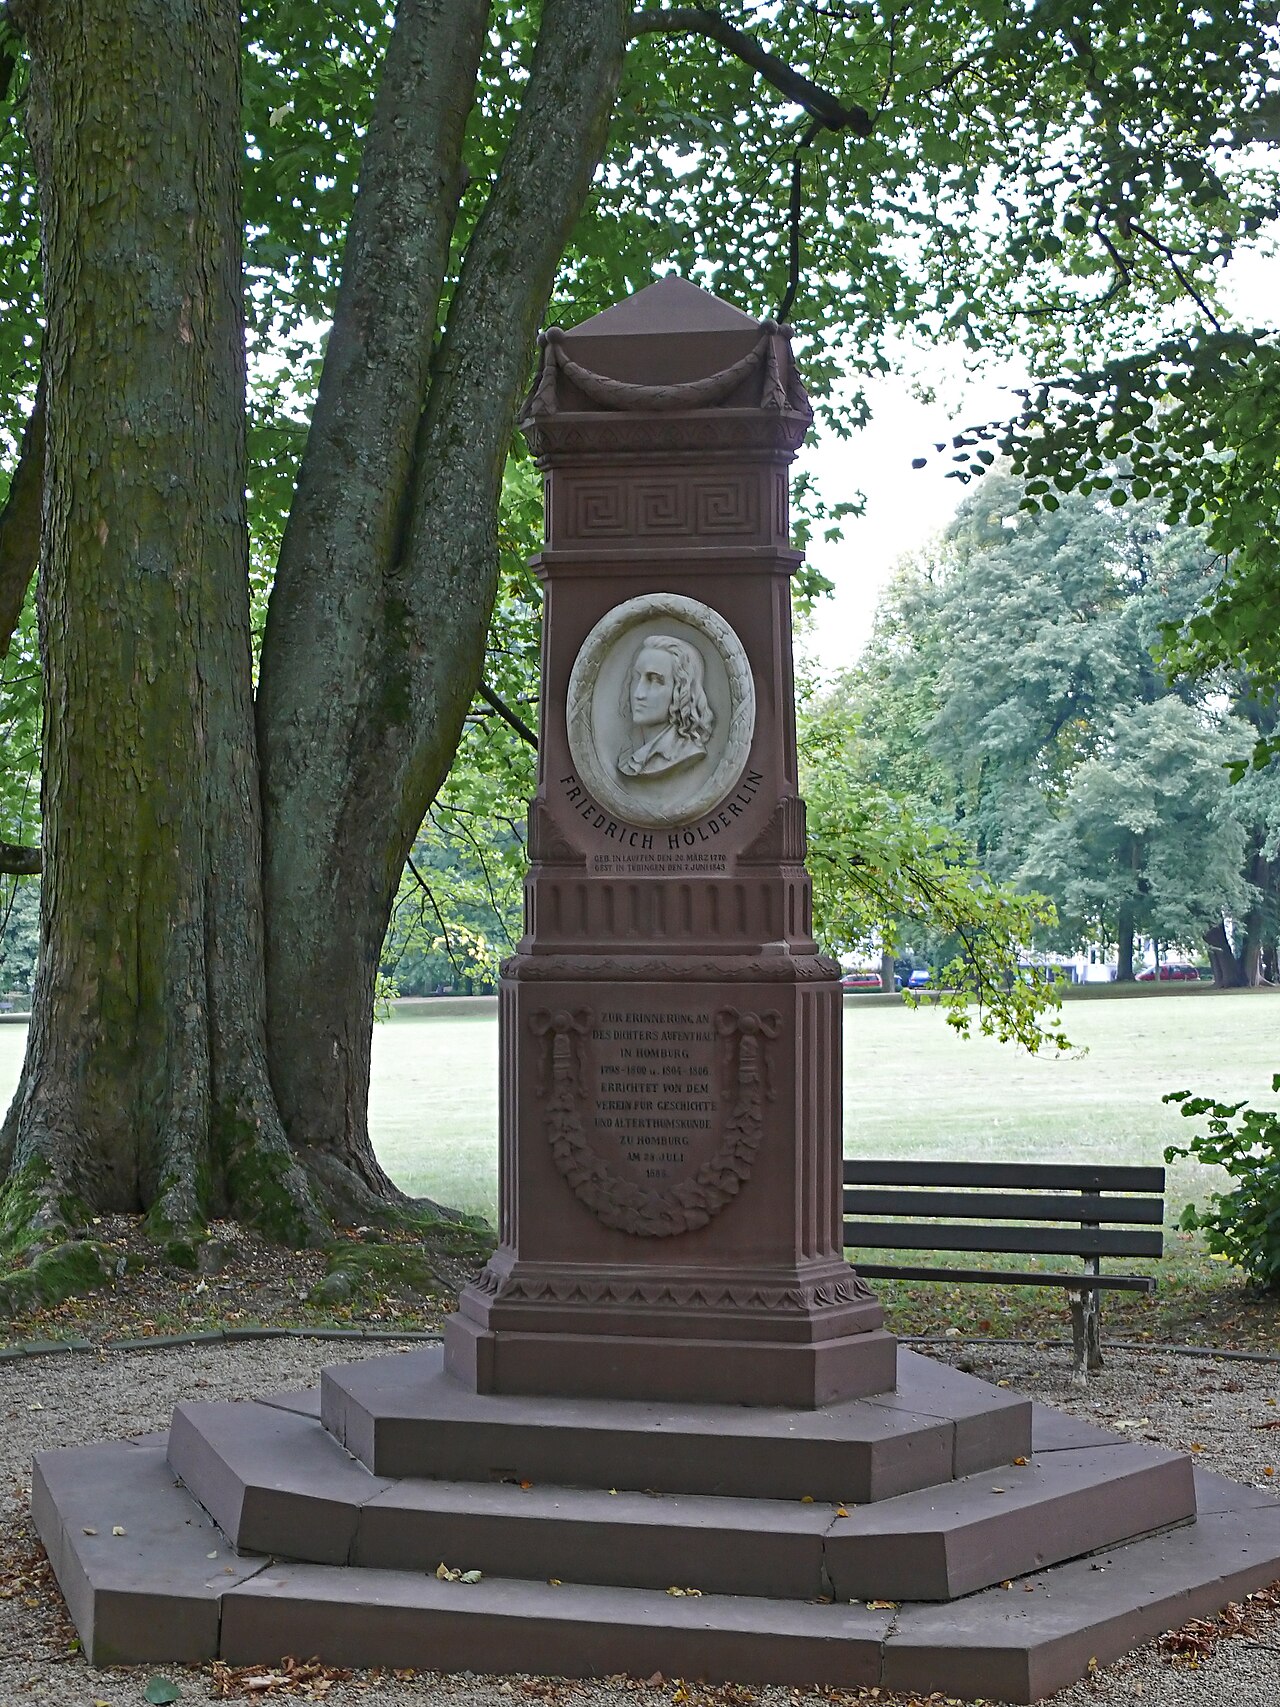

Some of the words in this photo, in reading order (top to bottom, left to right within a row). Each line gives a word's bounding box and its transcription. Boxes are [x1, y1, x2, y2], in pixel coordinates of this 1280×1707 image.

[560, 775, 653, 850] FRIEDRICH
[668, 770, 764, 850] HÖLDERLIN
[657, 854, 672, 862] DEN
[616, 864, 624, 872] IN
[667, 864, 682, 872] DEN
[690, 863, 708, 872] JUNI
[601, 1013, 622, 1023] ZUR
[626, 1013, 694, 1024] ERINNERUNG
[696, 1014, 709, 1024] AN
[592, 1030, 610, 1040] DES
[613, 1030, 659, 1041] DICHTERS
[661, 1031, 718, 1041] AUFENTHALT
[620, 1048, 632, 1058] IN
[636, 1048, 689, 1058] HOMBURG
[601, 1083, 658, 1093] ERRICHTET
[663, 1083, 682, 1093] VON
[686, 1083, 708, 1093] DEM
[596, 1100, 631, 1110] VEREIN
[657, 1101, 717, 1111] GESCHICHTE
[594, 1118, 612, 1128] UND
[620, 1136, 633, 1145] ZU
[637, 1136, 689, 1145] HOMBURG
[627, 1152, 640, 1162] AM
[659, 1152, 684, 1162] JULI
